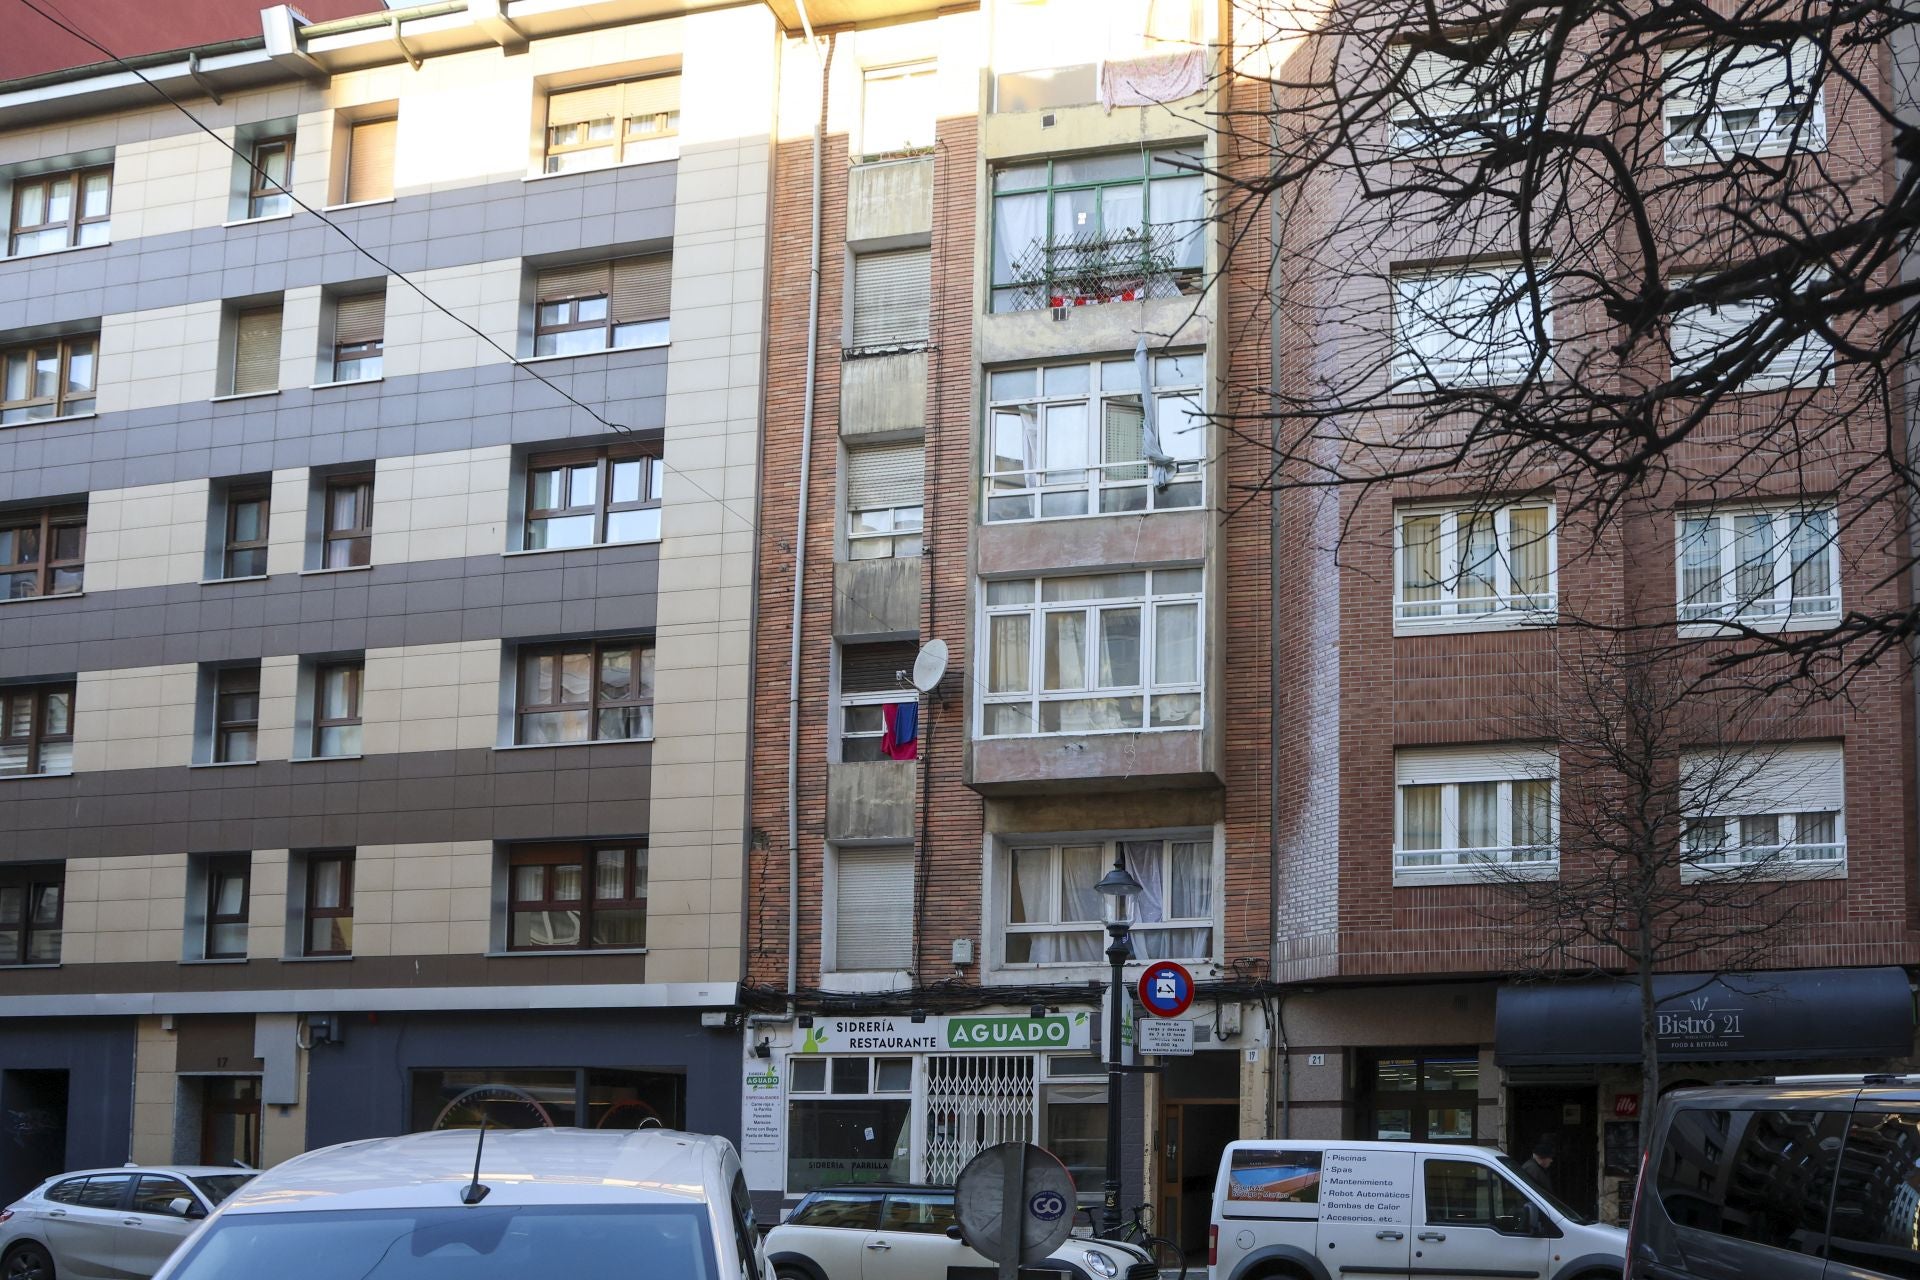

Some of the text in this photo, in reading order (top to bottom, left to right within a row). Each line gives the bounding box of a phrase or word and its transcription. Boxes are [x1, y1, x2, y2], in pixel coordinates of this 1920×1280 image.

[836, 1019, 895, 1033] SIDRERÍA
[1657, 1013, 1741, 1035] Bistró 21
[952, 1022, 1066, 1043] AGUADO
[849, 1037, 937, 1049] RESTAURANTE
[1248, 1051, 1256, 1060] 19
[217, 1057, 228, 1068] 17
[1312, 1056, 1321, 1065] 21
[1616, 1098, 1636, 1113] illy
[1332, 1154, 1367, 1162] Piscinas
[851, 1161, 889, 1169] PARRILLA
[1330, 1166, 1353, 1174] Spas
[1329, 1178, 1393, 1186] Mantenimiento
[1356, 1190, 1410, 1198] Automáticos
[1033, 1197, 1062, 1214] GO
[1327, 1202, 1362, 1210] Bombas
[1377, 1203, 1401, 1211] Calor
